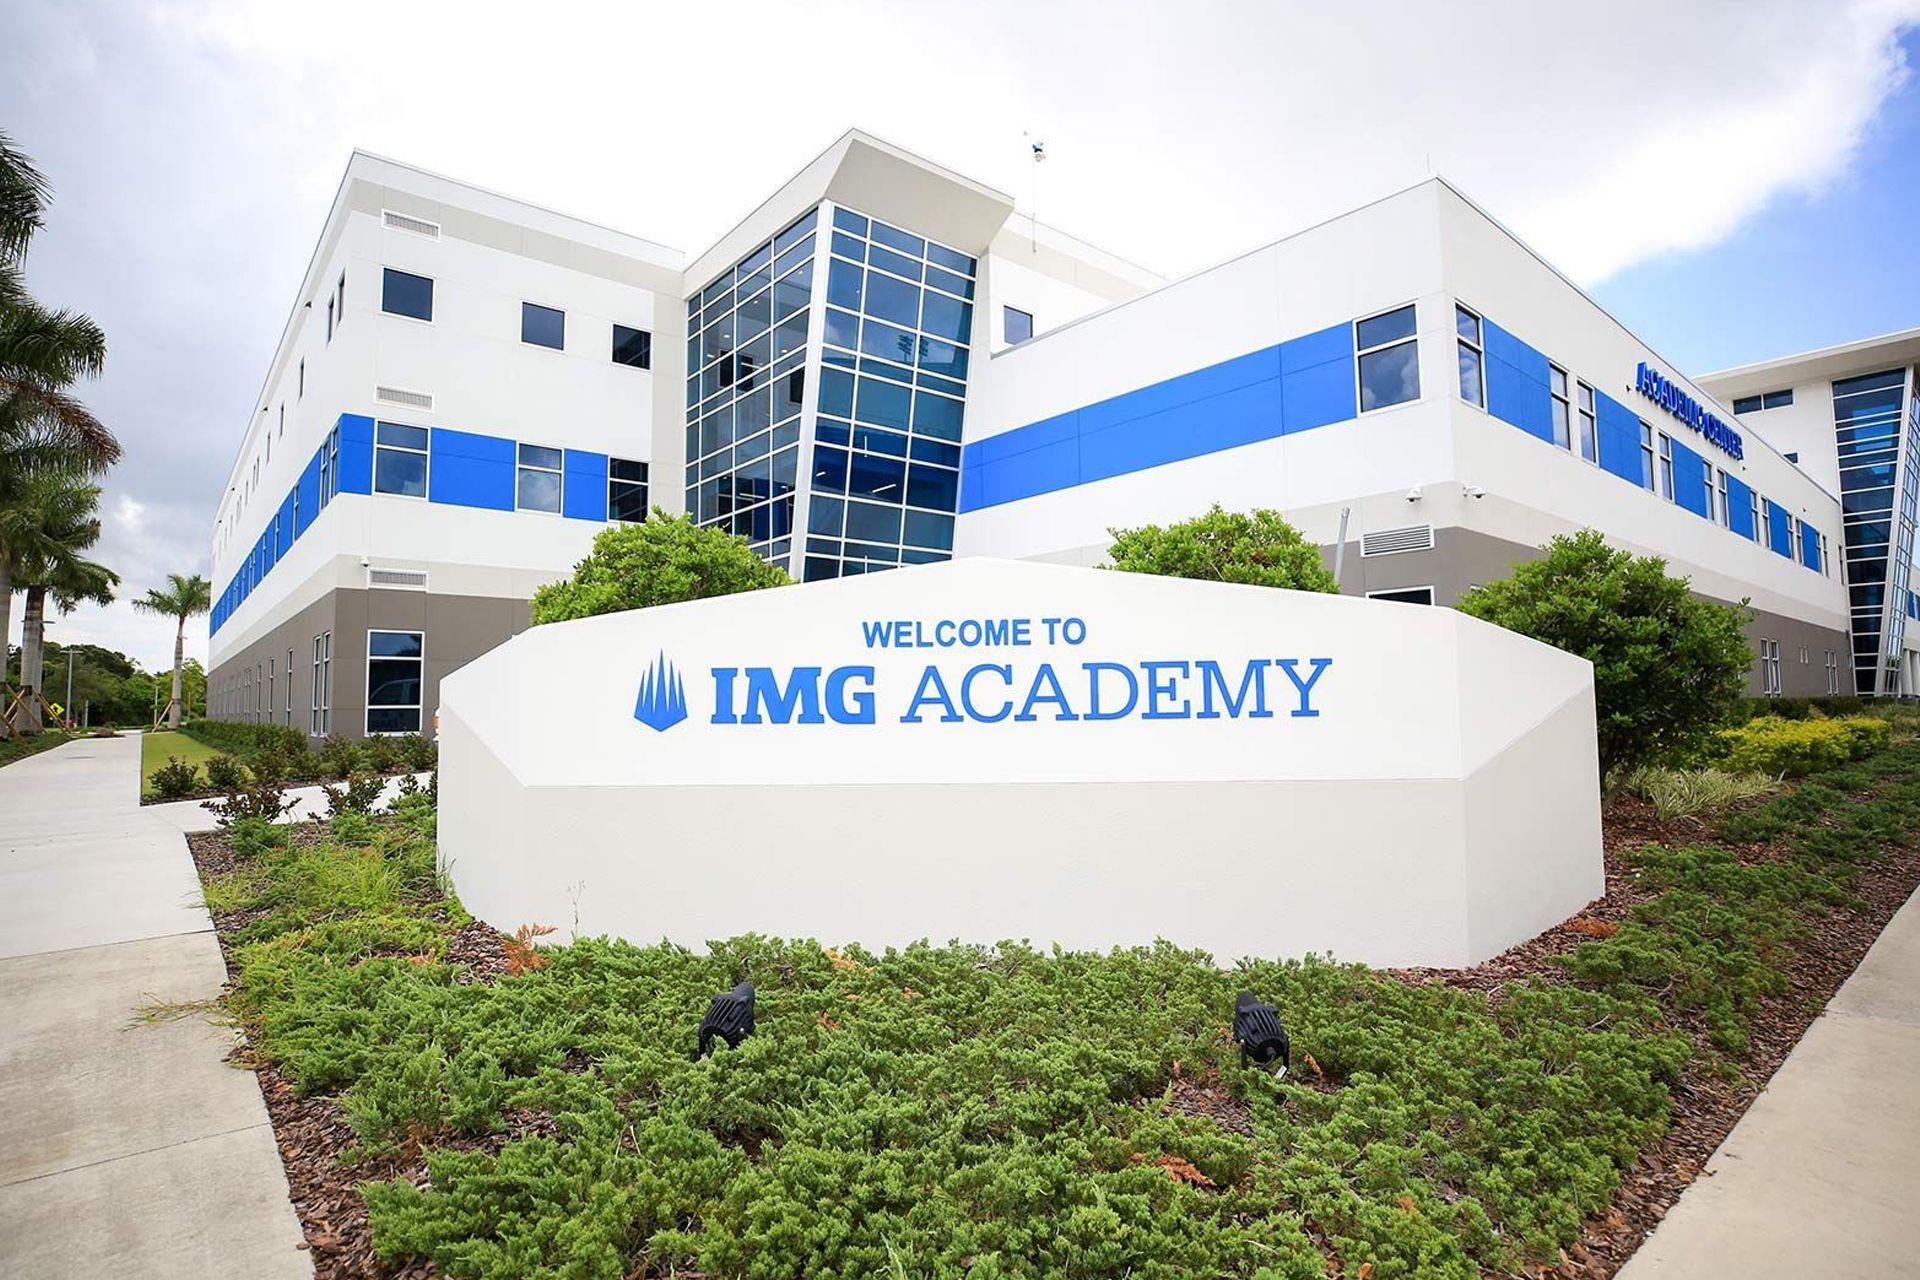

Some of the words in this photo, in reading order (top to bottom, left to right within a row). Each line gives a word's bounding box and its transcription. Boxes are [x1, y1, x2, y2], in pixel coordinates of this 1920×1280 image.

[1636, 361, 1704, 433] ACADEMIC
[1703, 412, 1744, 461] CENTER
[863, 619, 1031, 648] WELCOME
[1042, 617, 1087, 645] TO
[711, 665, 877, 725] IMG
[901, 658, 1333, 723] ACADEMY
